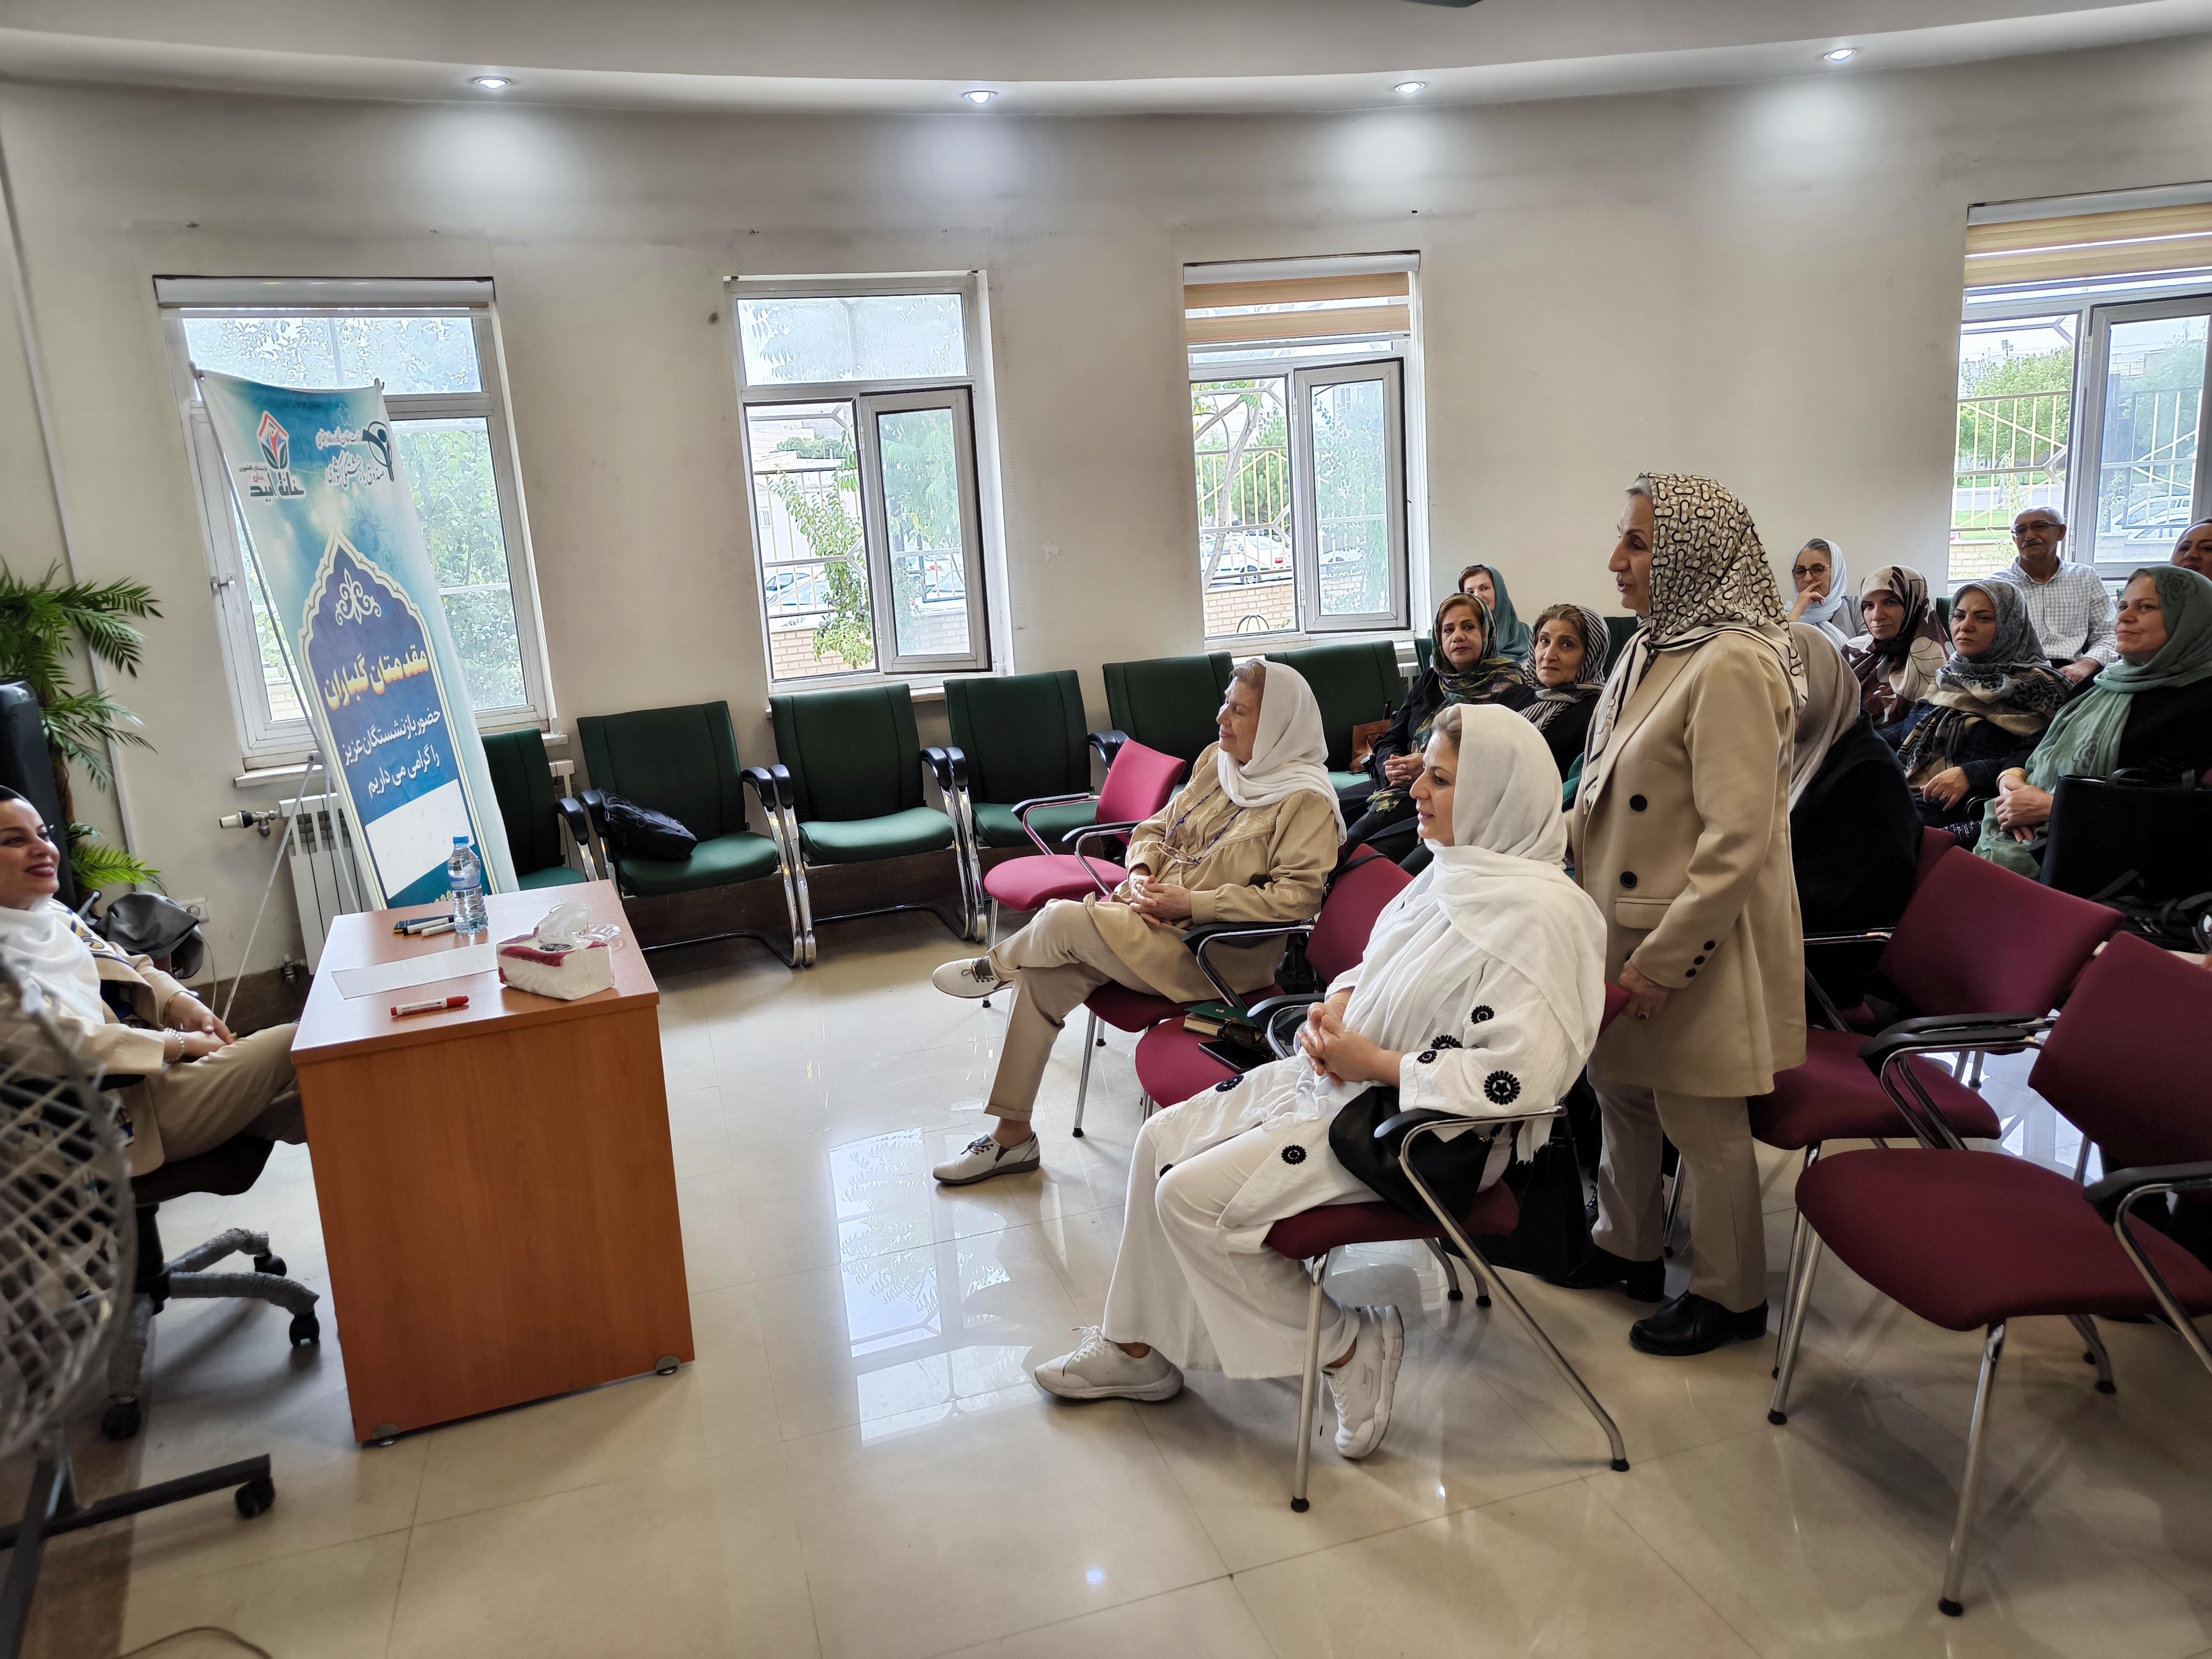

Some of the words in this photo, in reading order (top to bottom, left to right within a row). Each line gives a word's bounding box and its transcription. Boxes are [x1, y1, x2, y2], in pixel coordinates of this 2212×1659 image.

[367, 466, 385, 485] صندوق
[324, 652, 369, 711] گلباران
[370, 644, 429, 696] مقدمتان
[362, 713, 419, 755] بازنشستگان
[416, 707, 441, 736] حضور
[342, 739, 363, 766] عزیز
[407, 743, 431, 779] گرامی
[430, 744, 440, 767] را
[368, 766, 392, 800] داریم
[392, 766, 406, 786] می
